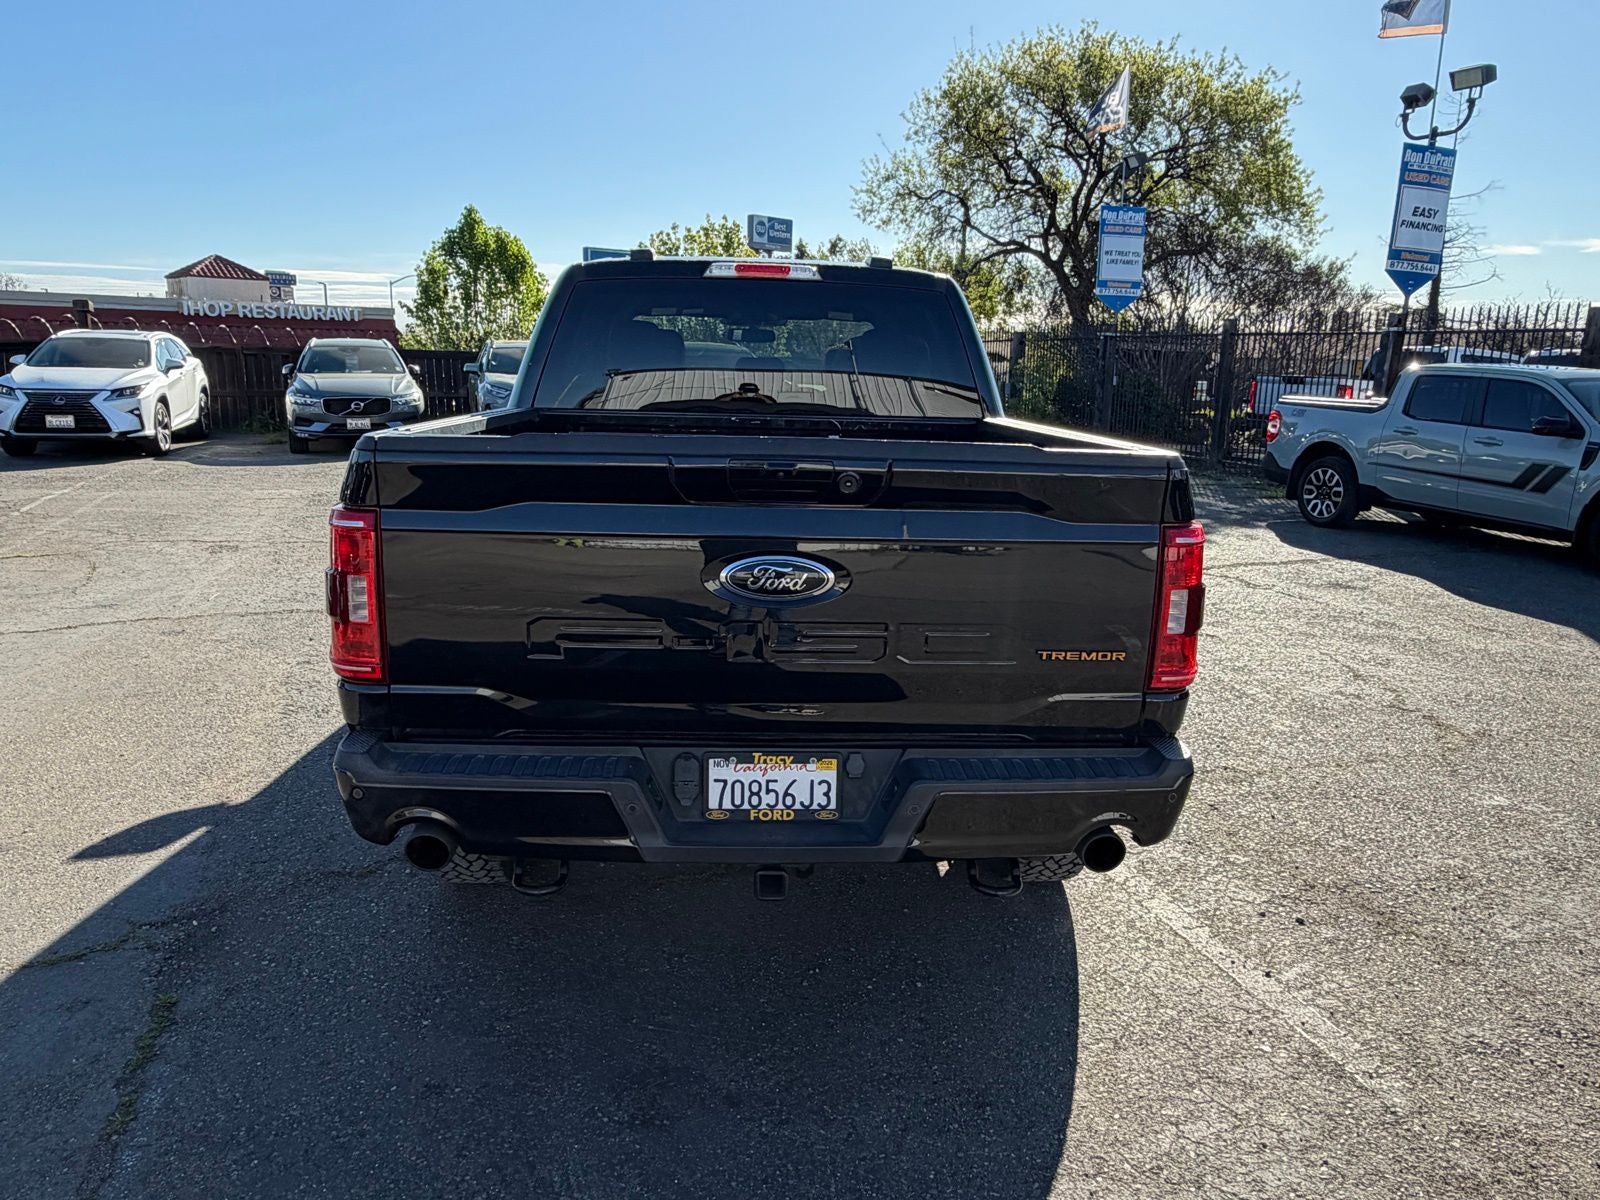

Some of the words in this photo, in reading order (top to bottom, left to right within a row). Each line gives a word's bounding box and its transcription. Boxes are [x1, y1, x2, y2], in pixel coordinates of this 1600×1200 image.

[1404, 149, 1423, 163] Ron
[1423, 151, 1455, 168] DuPratt
[1404, 171, 1430, 182] USED
[1411, 206, 1440, 219] EASY
[774, 222, 787, 231] Best
[1400, 220, 1444, 233] FINANCING
[769, 229, 791, 239] Western
[182, 300, 233, 318] IHOP
[237, 301, 362, 321] RESTAURANT
[747, 565, 809, 591] Ford
[1037, 651, 1127, 661] TREMOR
[713, 760, 730, 768] NOV
[752, 752, 795, 765] Tracy
[733, 763, 808, 778] California
[713, 779, 832, 809] 70856J3
[750, 810, 795, 820] FORD
